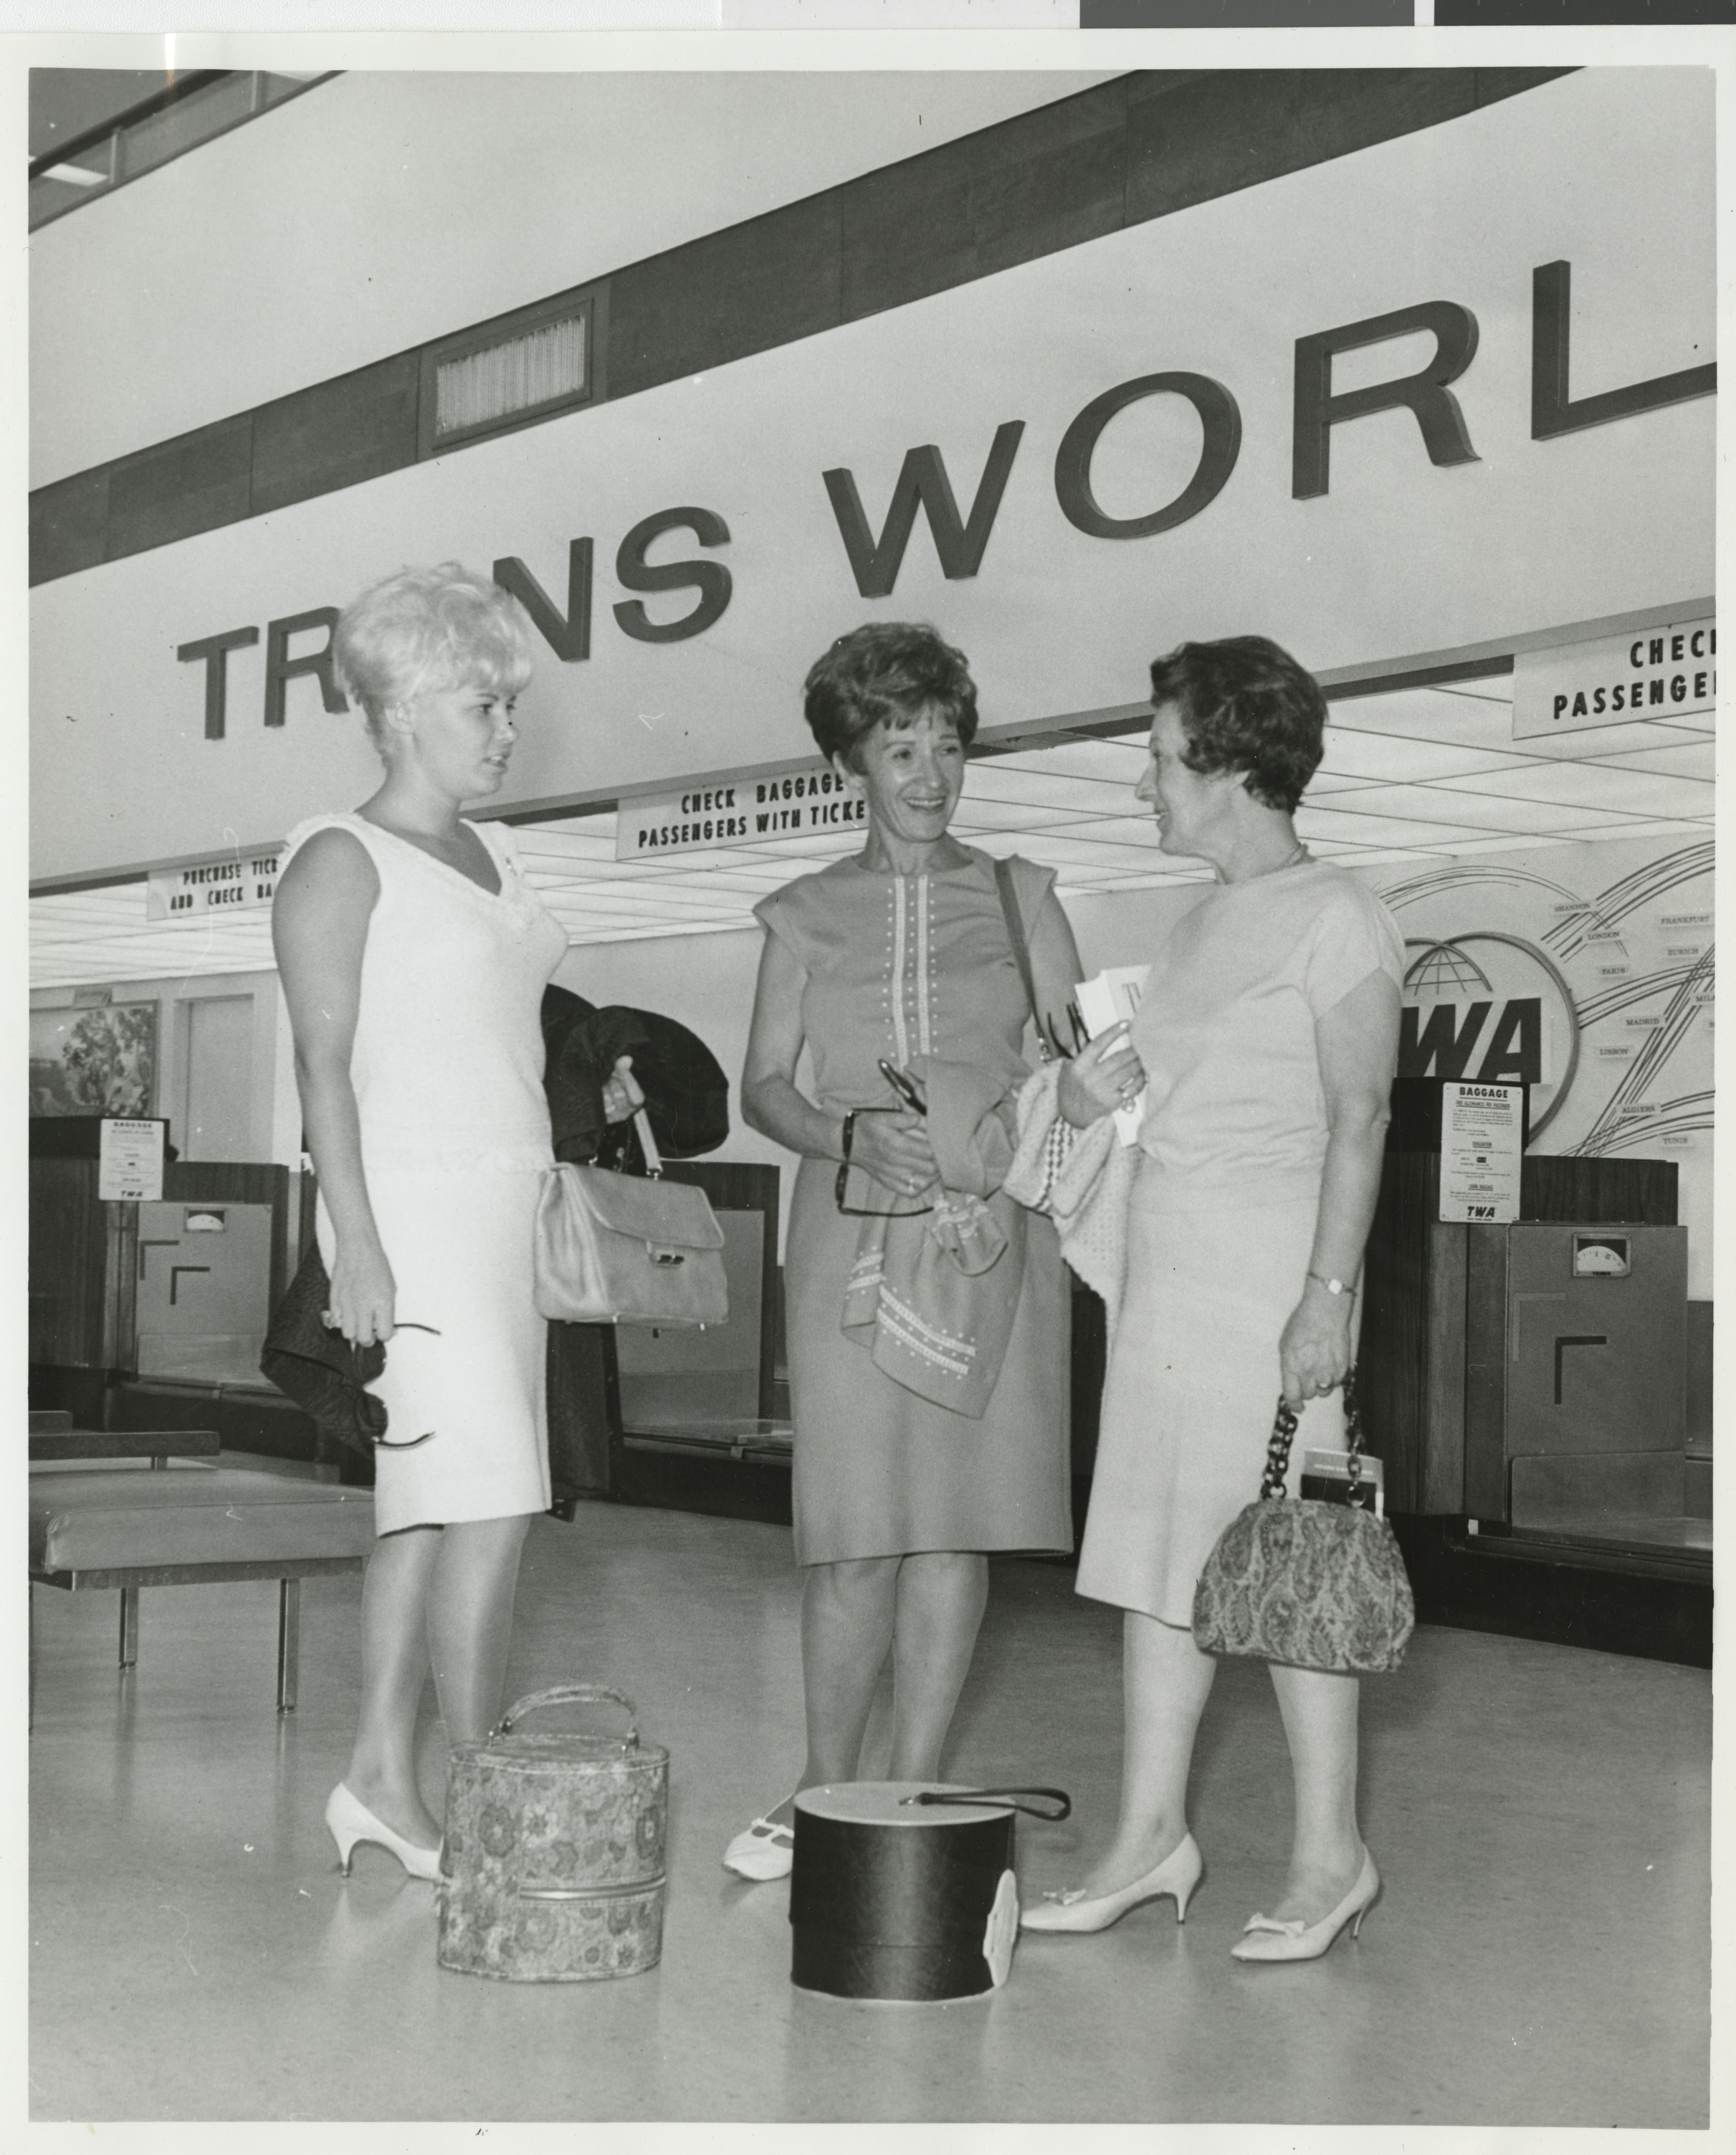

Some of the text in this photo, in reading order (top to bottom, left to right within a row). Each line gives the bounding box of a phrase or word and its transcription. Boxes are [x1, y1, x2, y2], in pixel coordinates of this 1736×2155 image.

[177, 260, 1717, 741] TRNS WORL
[1553, 670, 1716, 720] PASSENGE
[682, 773, 844, 814] CHECK BAGGAGE
[639, 816, 747, 848] PASSENGERS
[756, 808, 801, 832] WITH
[183, 863, 242, 885] PURCHASE
[170, 894, 194, 910] AND
[208, 886, 244, 905] CHECK
[1554, 902, 1591, 913] SHANNON
[1660, 915, 1710, 926] FRANKFURT
[1588, 931, 1621, 941] LONDON
[1667, 947, 1699, 956] ZURICH
[1601, 967, 1626, 976] PARIS
[1626, 1018, 1660, 1027] MADRID
[1459, 1086, 1509, 1099] BAGGAGE
[1622, 1105, 1656, 1114] ALGIERS
[1467, 1205, 1496, 1218] TWA
